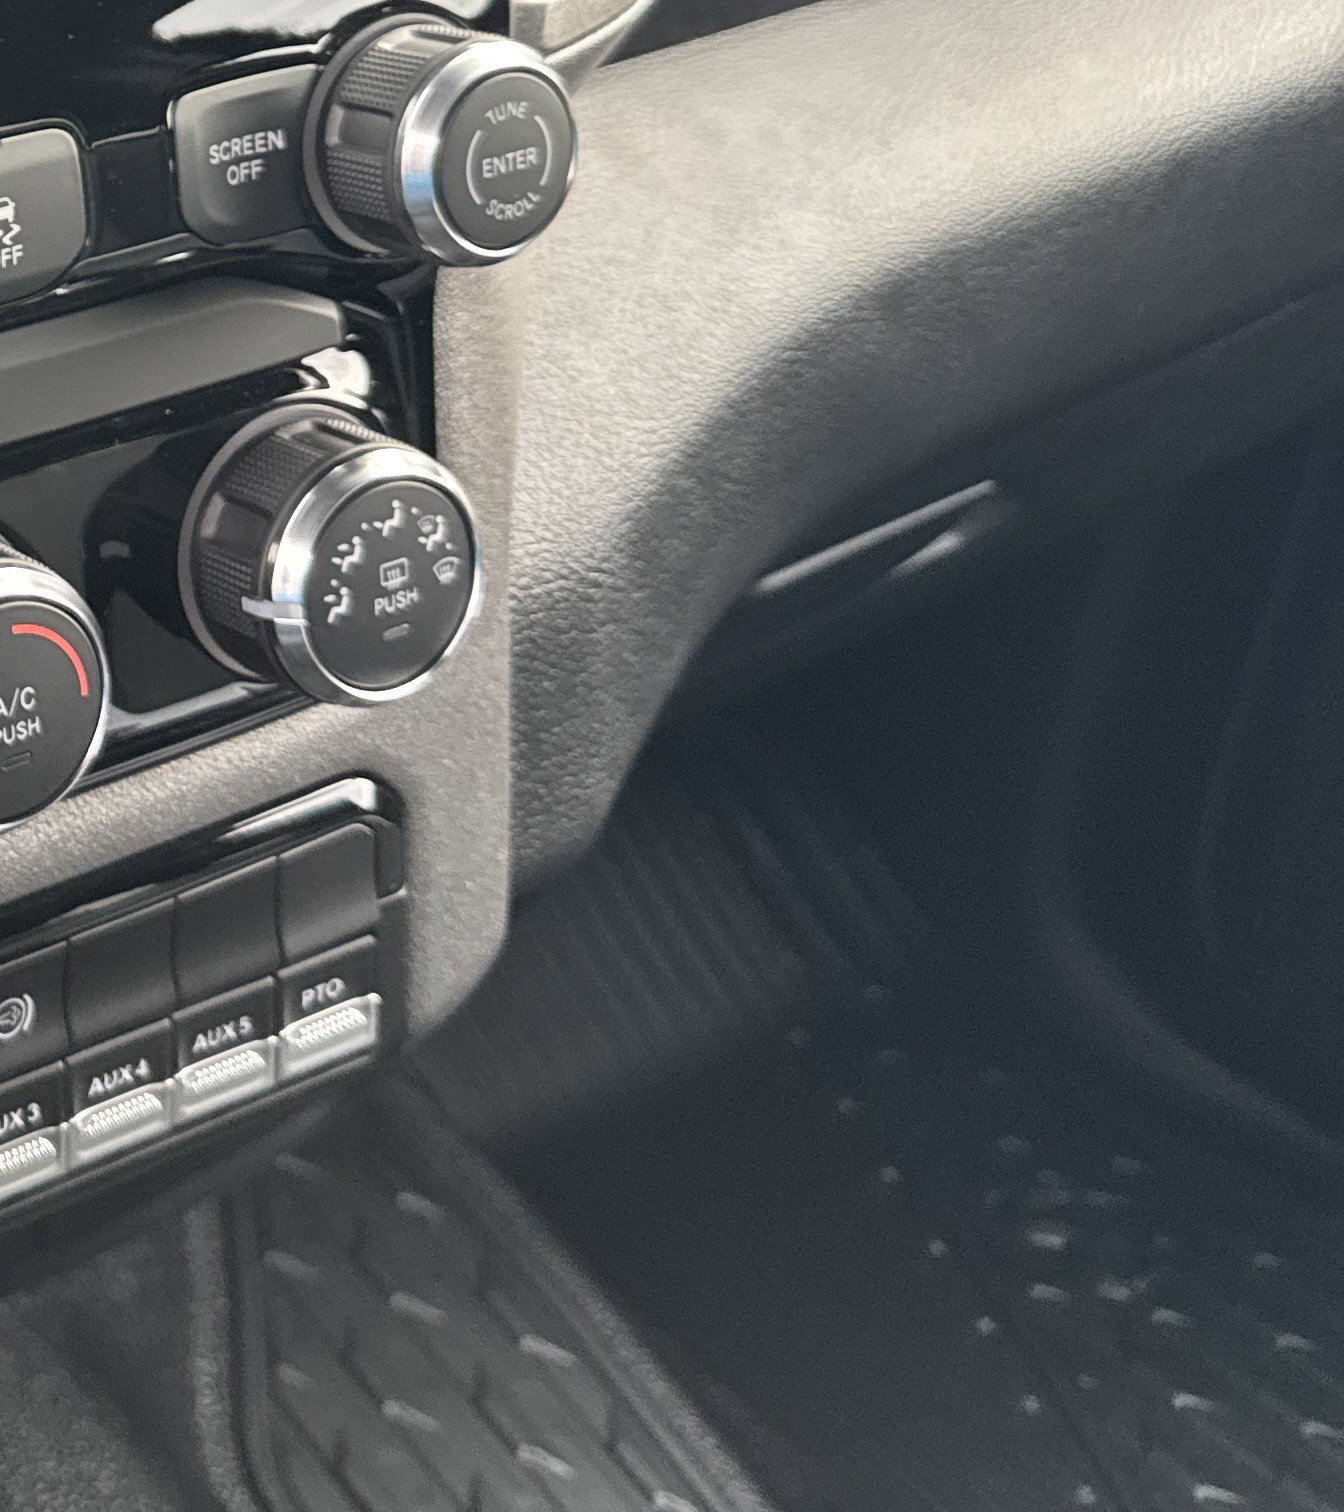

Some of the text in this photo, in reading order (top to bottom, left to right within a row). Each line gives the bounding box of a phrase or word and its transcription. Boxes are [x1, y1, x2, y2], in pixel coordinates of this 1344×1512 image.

[484, 100, 530, 125] TUNE
[209, 129, 285, 164] SCREEN
[483, 146, 537, 178] ENTER
[227, 159, 262, 186] OFF
[485, 190, 543, 221] SCROLL
[373, 587, 418, 617] PUSH
[301, 977, 346, 1008] PTO
[193, 1015, 253, 1053] AUX 5
[89, 1057, 150, 1096] AUX 4
[26, 1102, 42, 1124] 3
